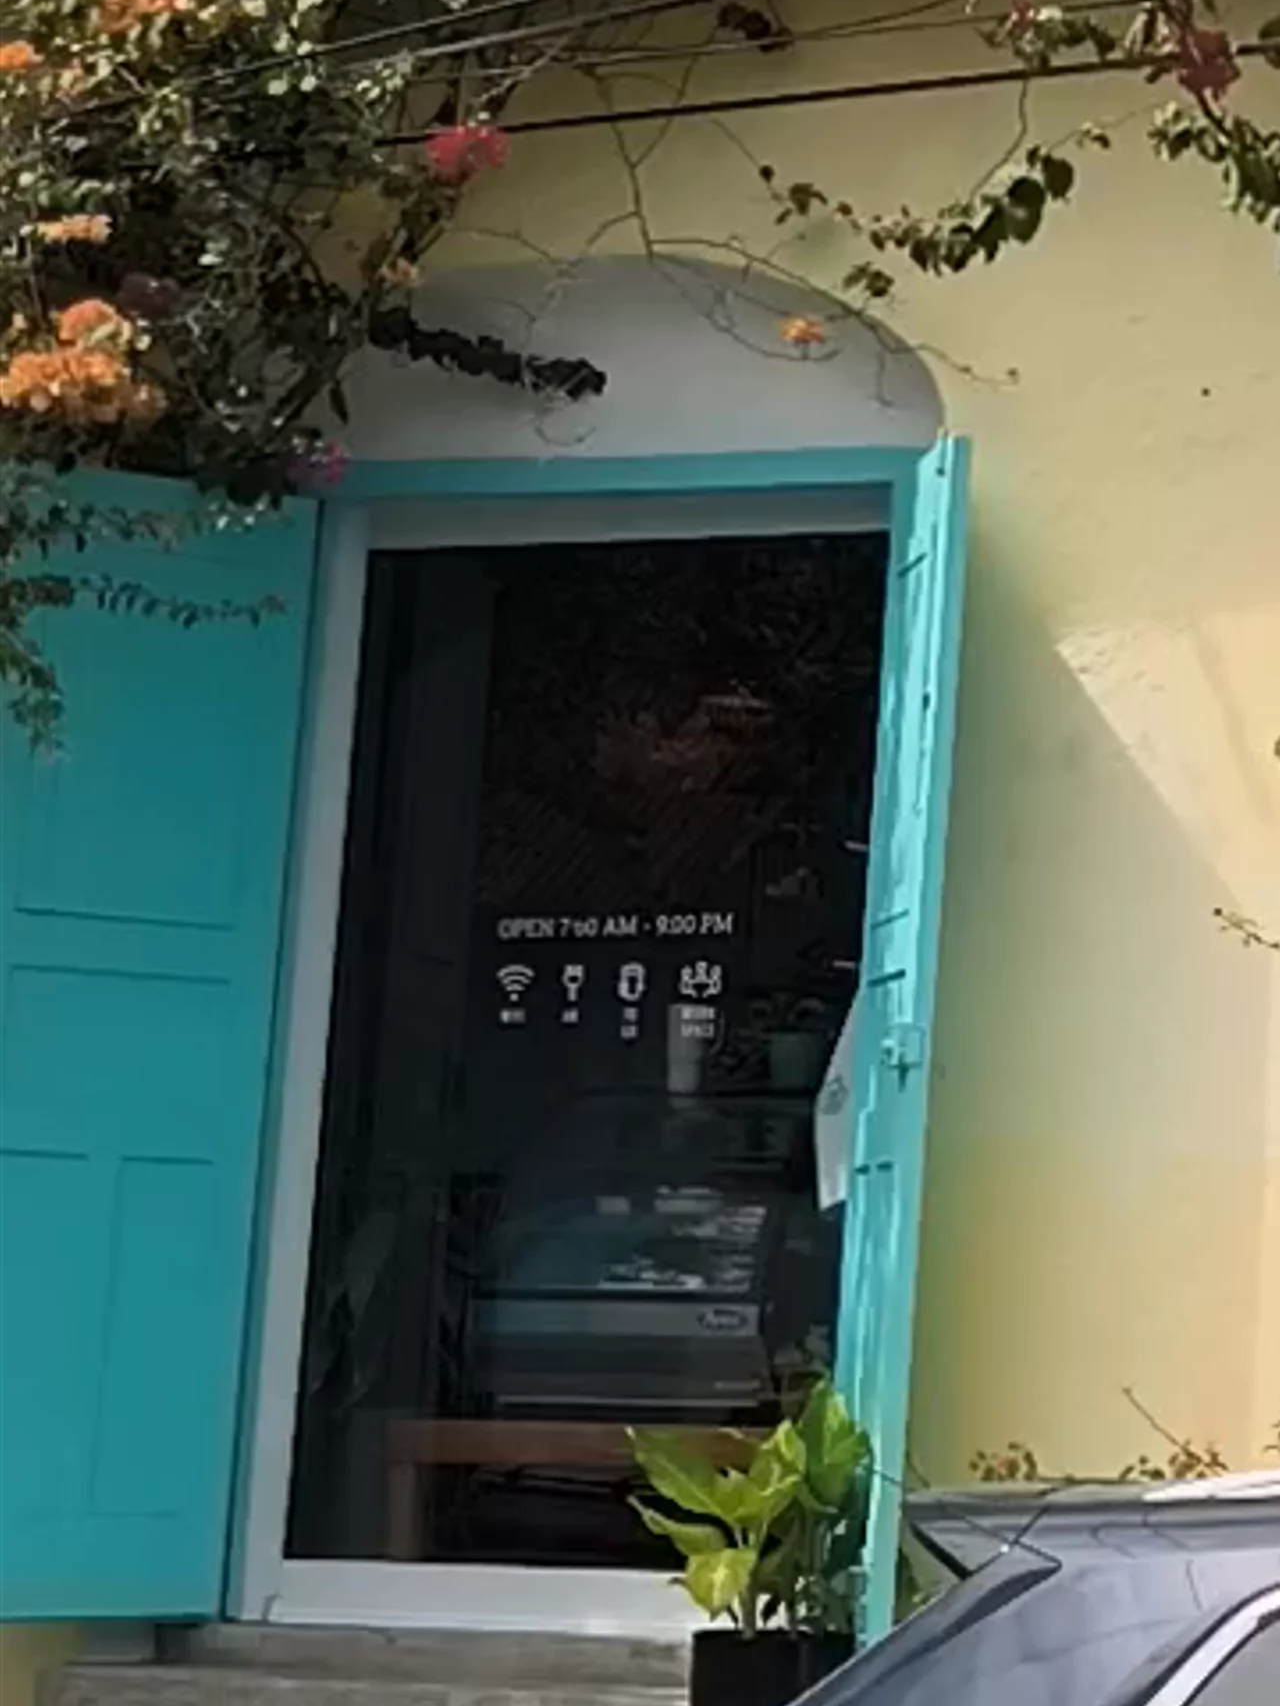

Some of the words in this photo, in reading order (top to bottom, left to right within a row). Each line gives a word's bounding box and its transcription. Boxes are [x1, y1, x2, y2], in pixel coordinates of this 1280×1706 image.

[498, 918, 555, 939] OPEN
[602, 915, 638, 935] AM
[655, 914, 697, 935] 9:00
[699, 911, 733, 934] PM
